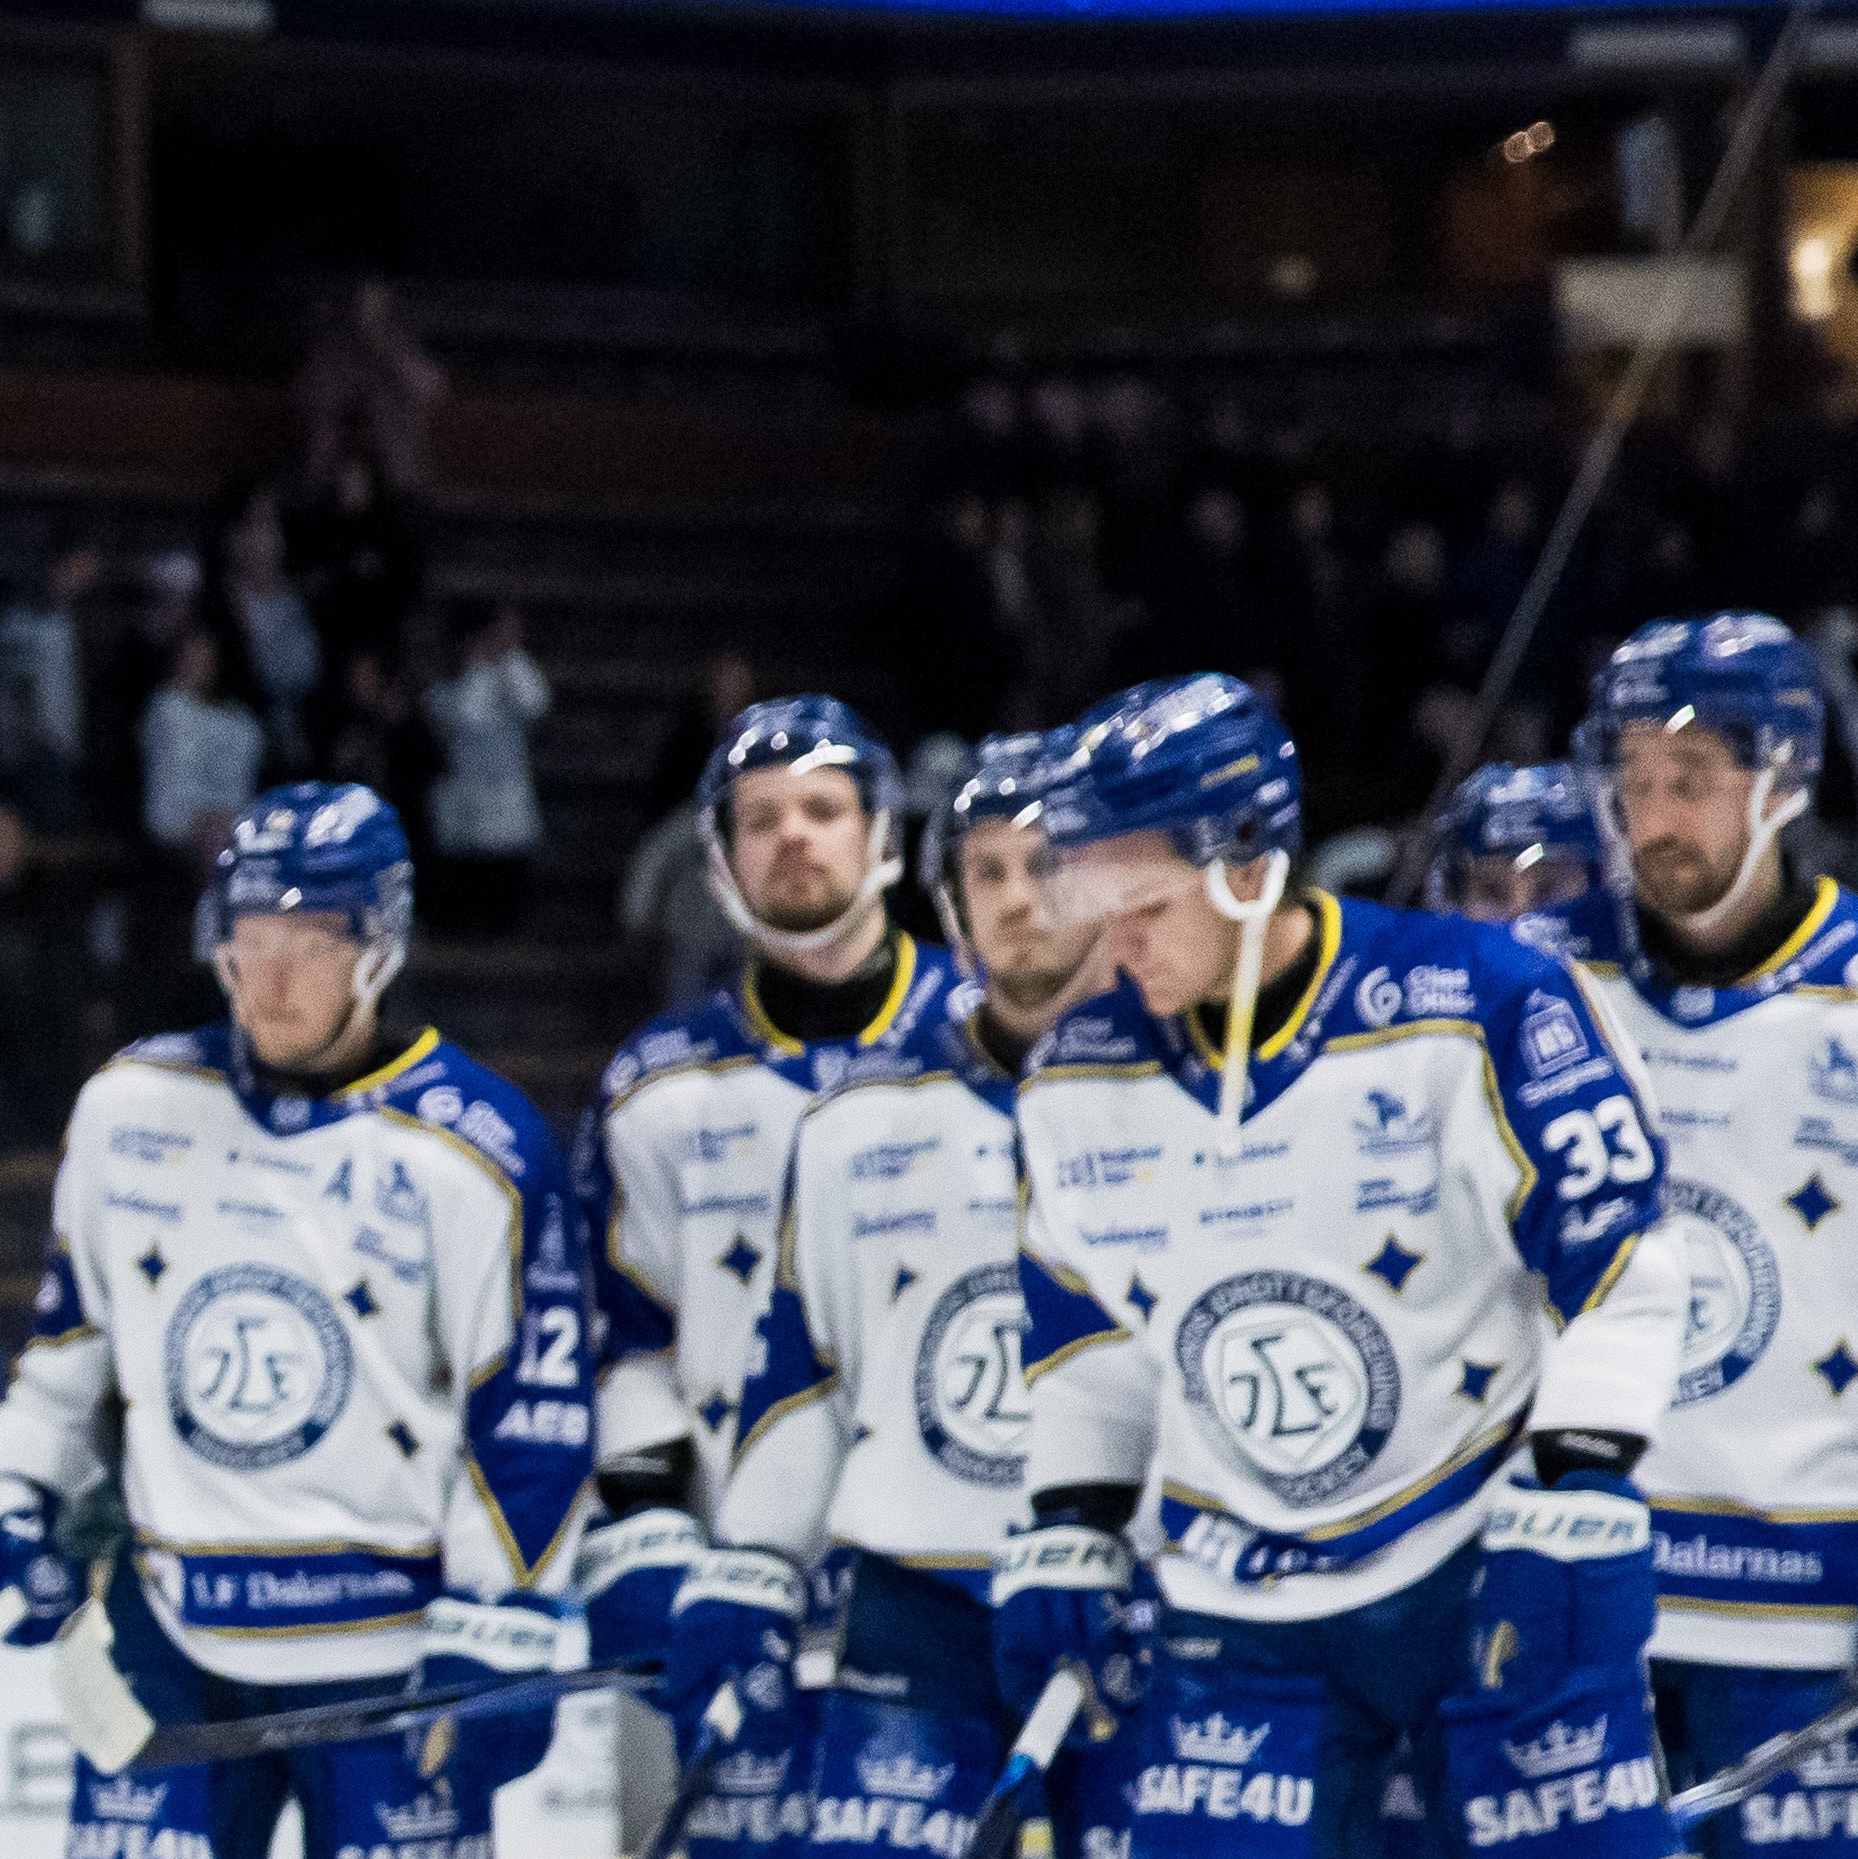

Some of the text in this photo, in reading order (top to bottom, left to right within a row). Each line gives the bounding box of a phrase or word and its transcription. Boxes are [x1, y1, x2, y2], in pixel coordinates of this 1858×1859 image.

[1541, 1094, 1655, 1200] 33
[492, 1401, 588, 1446] AEB
[1137, 1760, 1315, 1828] SAFE4U
[1464, 1756, 1660, 1847] SAFE4U
